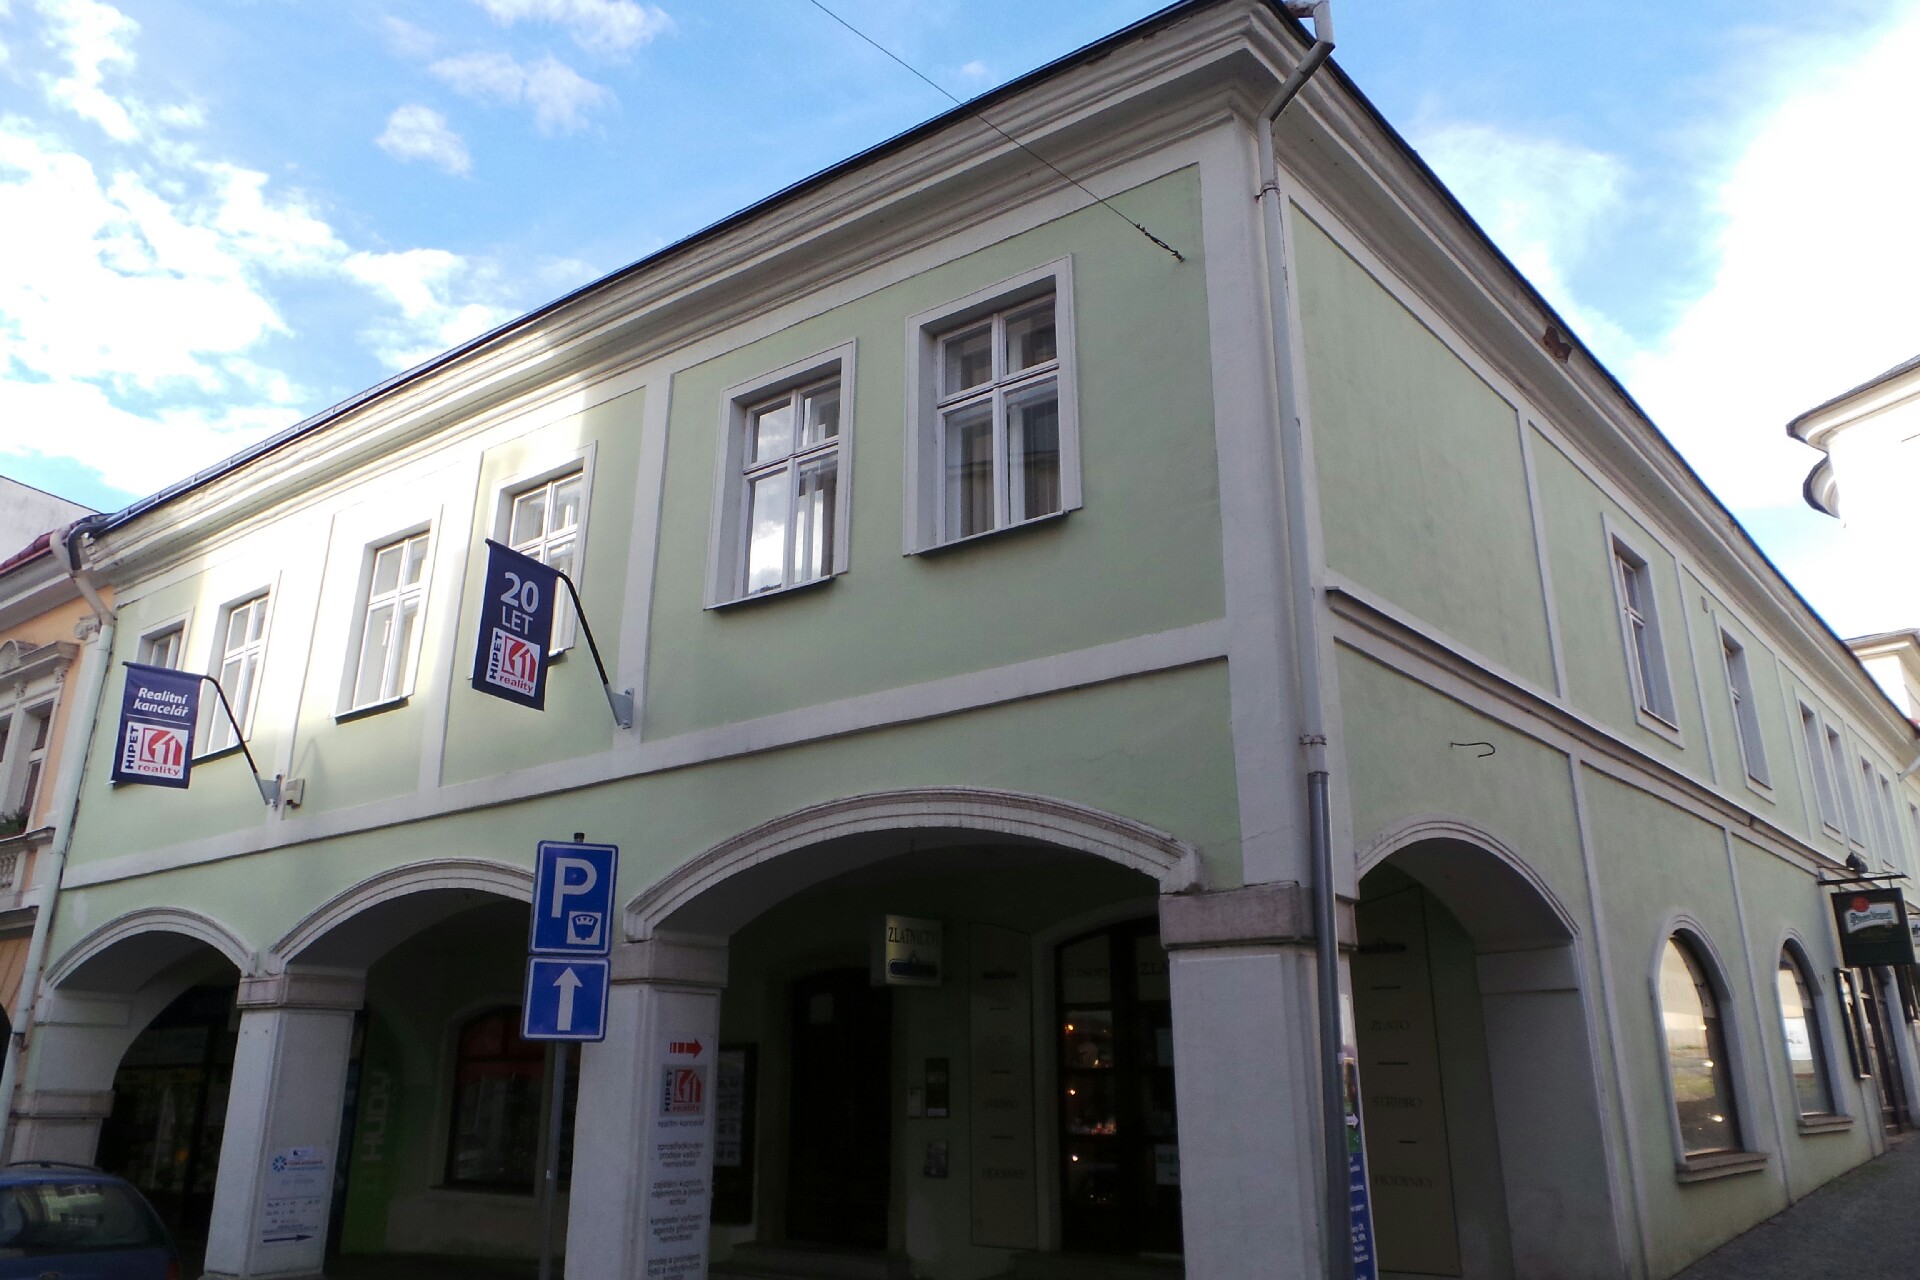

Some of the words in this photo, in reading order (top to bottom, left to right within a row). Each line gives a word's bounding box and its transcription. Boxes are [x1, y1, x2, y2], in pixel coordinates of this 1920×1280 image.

[500, 571, 540, 614] 20
[501, 606, 534, 635] LET
[489, 632, 503, 679] HIPET
[138, 687, 189, 705] Realitní
[500, 675, 533, 693] reality
[133, 698, 189, 717] kancelář
[125, 726, 139, 769] HIPET
[138, 765, 180, 776] reality
[551, 857, 598, 919] P
[664, 1069, 673, 1113] HIPET
[672, 1104, 700, 1113] reality
